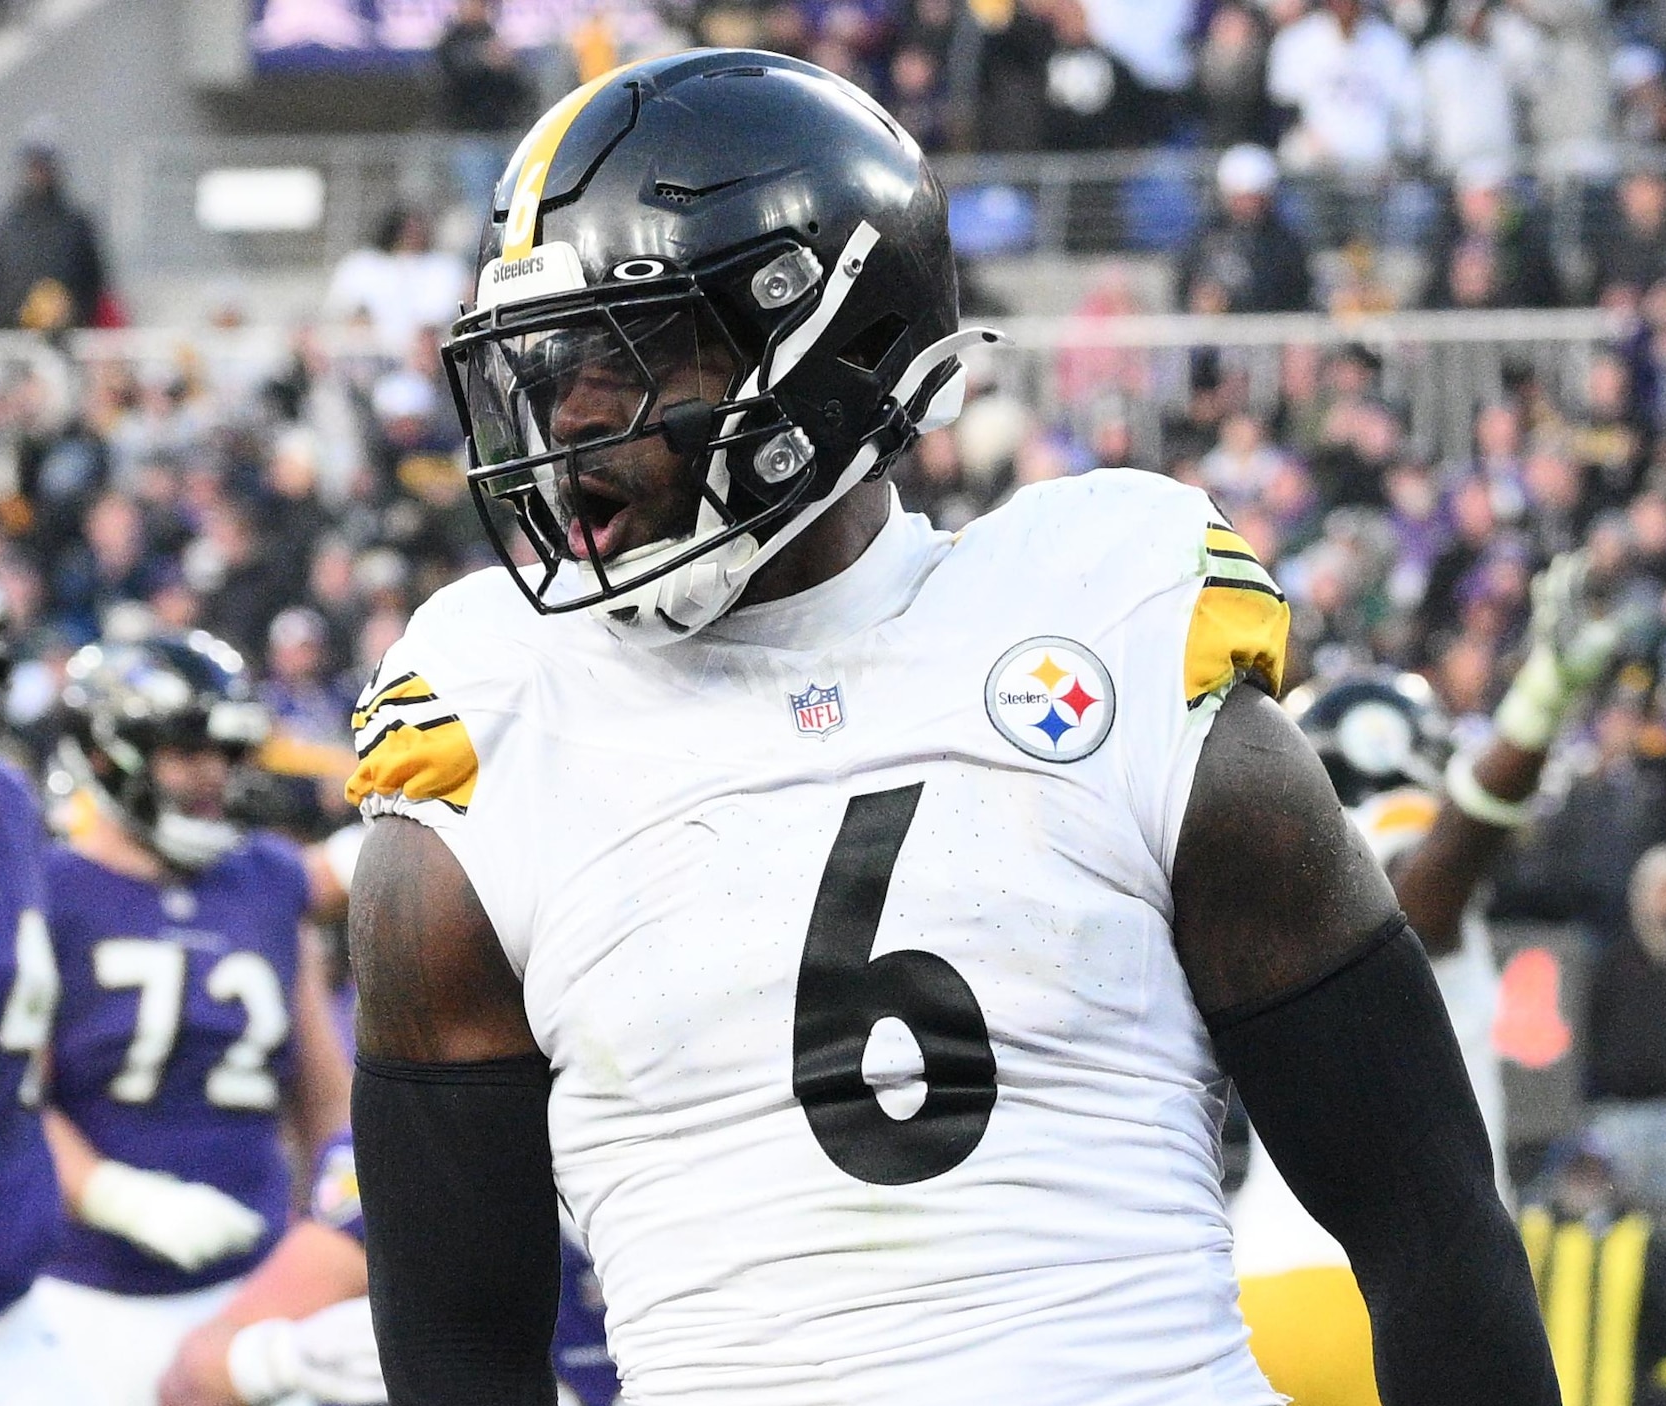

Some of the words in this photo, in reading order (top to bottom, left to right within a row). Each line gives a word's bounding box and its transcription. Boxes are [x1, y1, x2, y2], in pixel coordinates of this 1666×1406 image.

[505, 161, 545, 247] 6
[493, 256, 544, 284] Steelers
[799, 704, 838, 728] NFL
[998, 691, 1049, 705] Steelers
[793, 781, 998, 1185] 6
[92, 936, 290, 1110] 72
